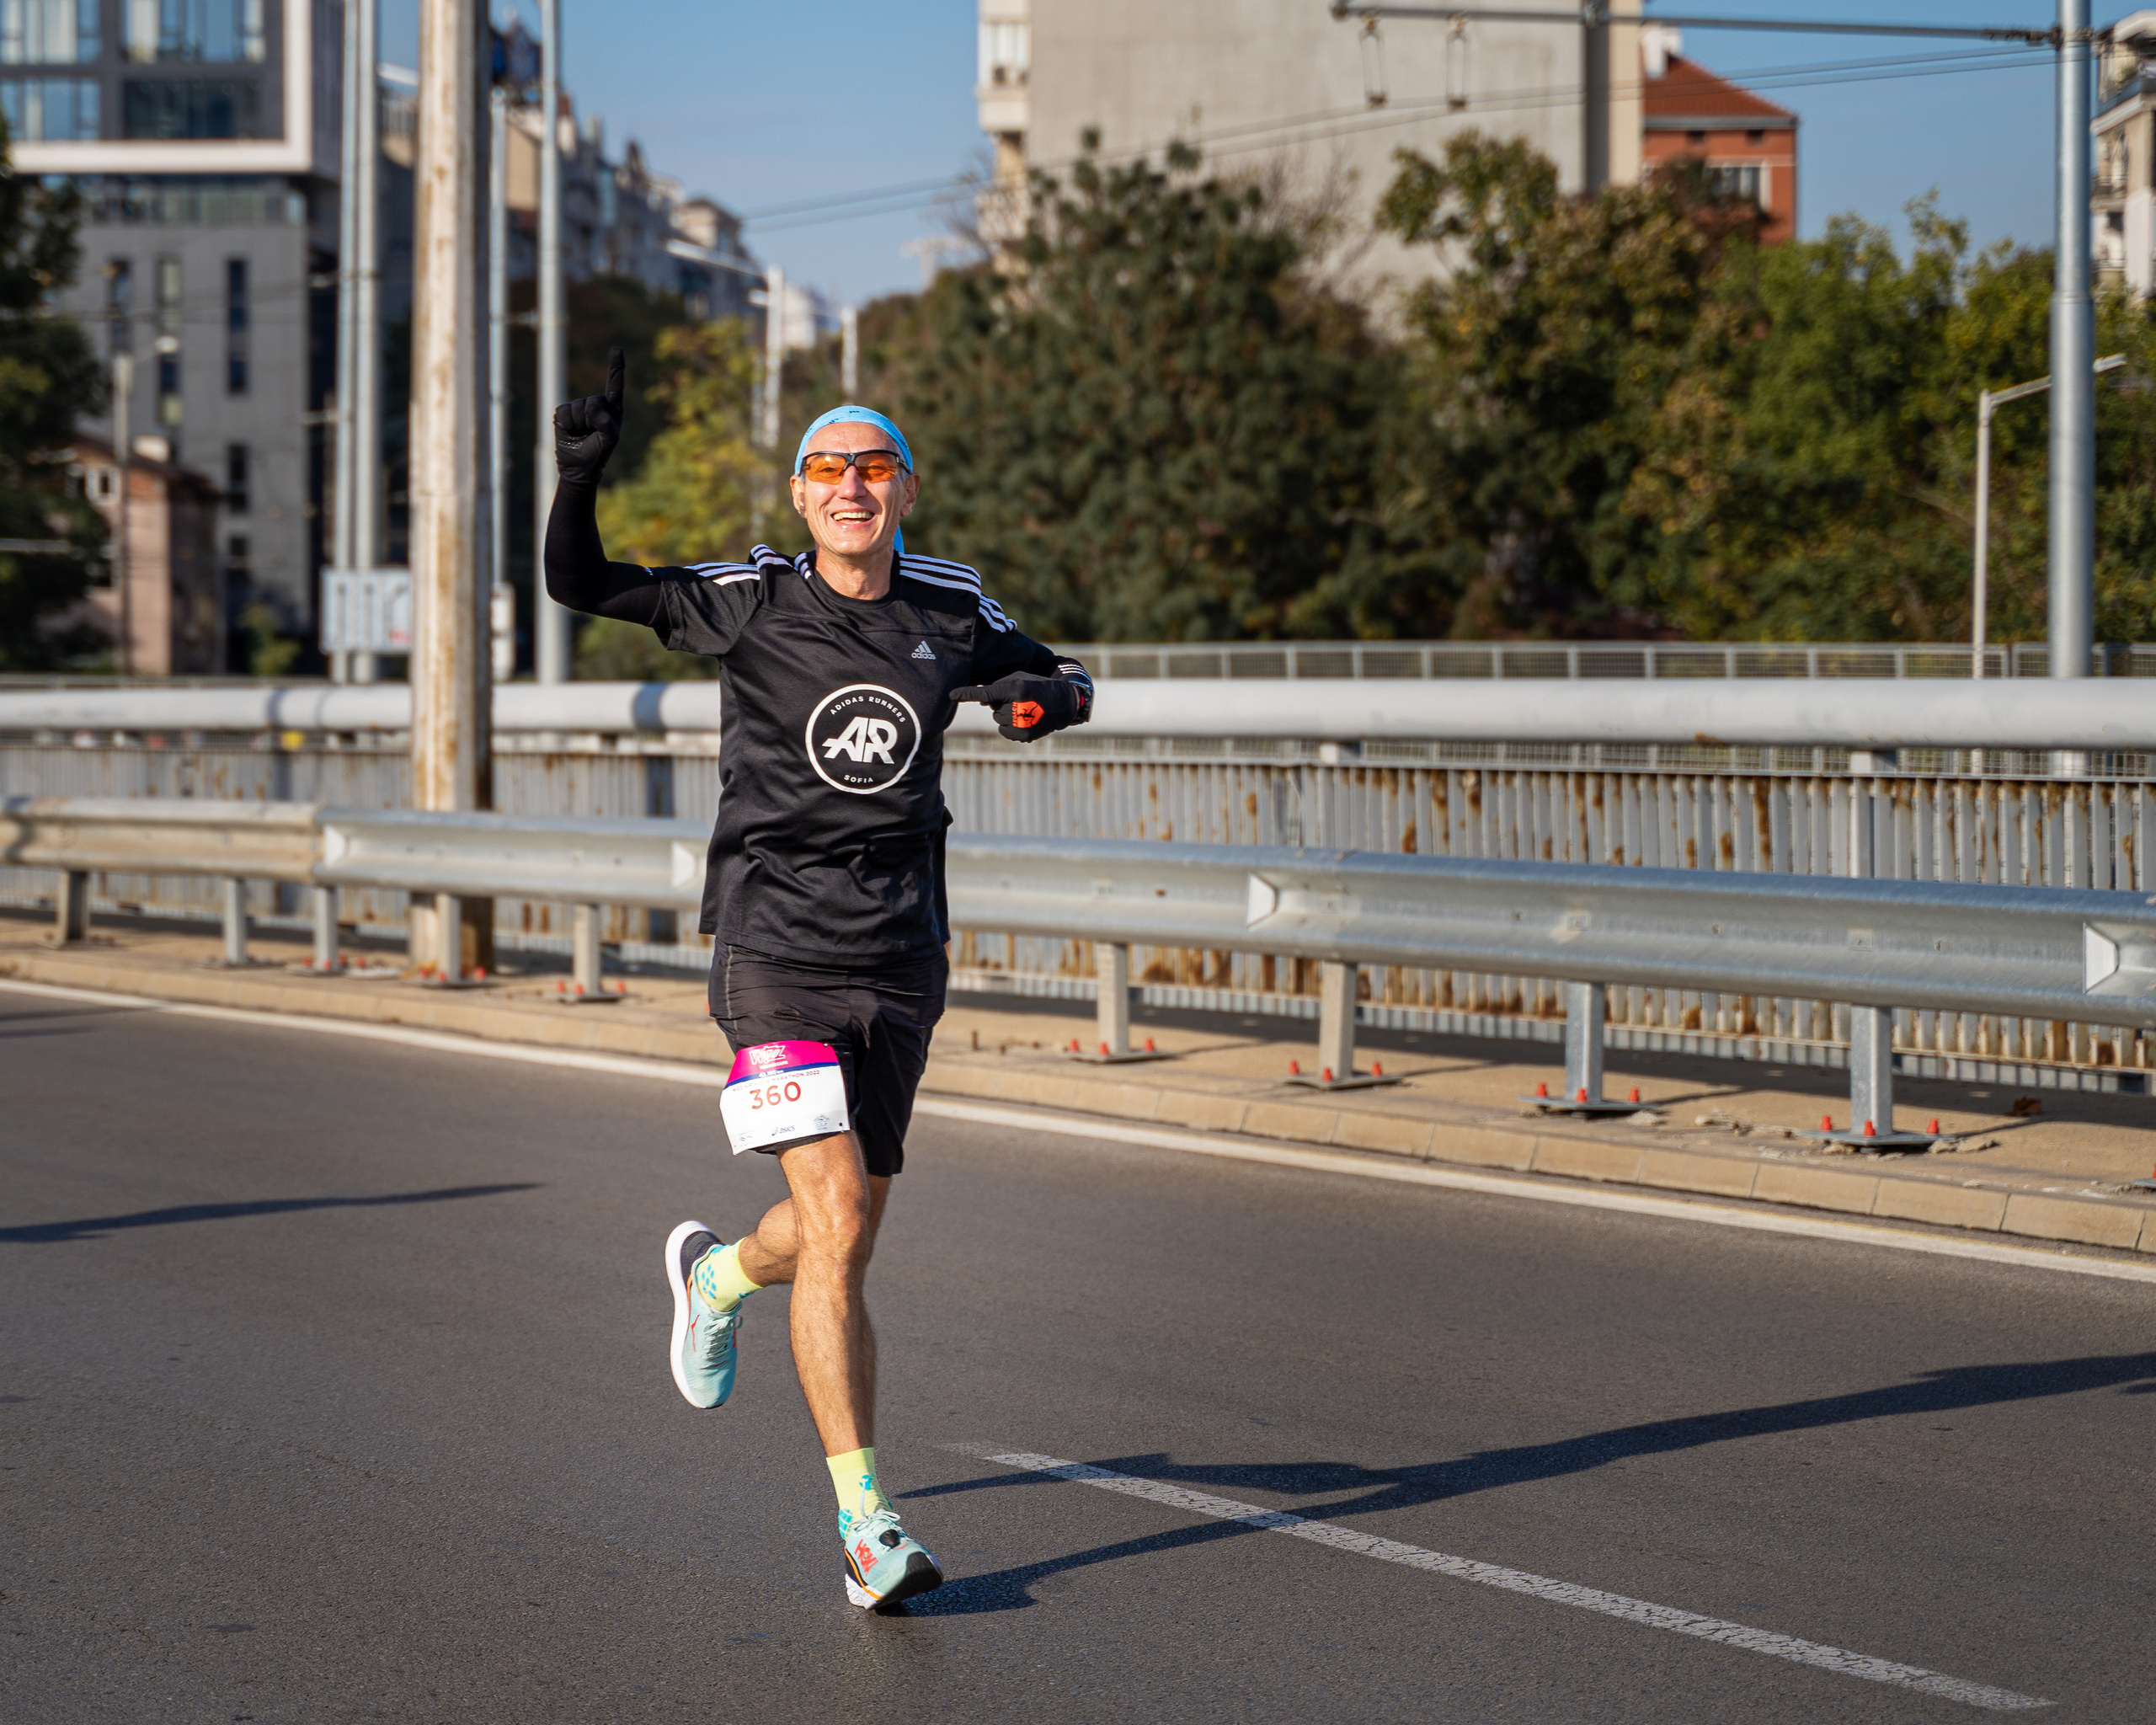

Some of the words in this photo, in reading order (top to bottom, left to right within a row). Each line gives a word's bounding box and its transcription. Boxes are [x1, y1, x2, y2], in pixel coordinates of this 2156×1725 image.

[910, 652, 937, 660] adidas
[830, 696, 864, 715] ADIDAS
[868, 696, 906, 723] RUNNERS
[821, 716, 898, 765] AR
[843, 774, 874, 783] SOFIA
[750, 1081, 802, 1110] 360
